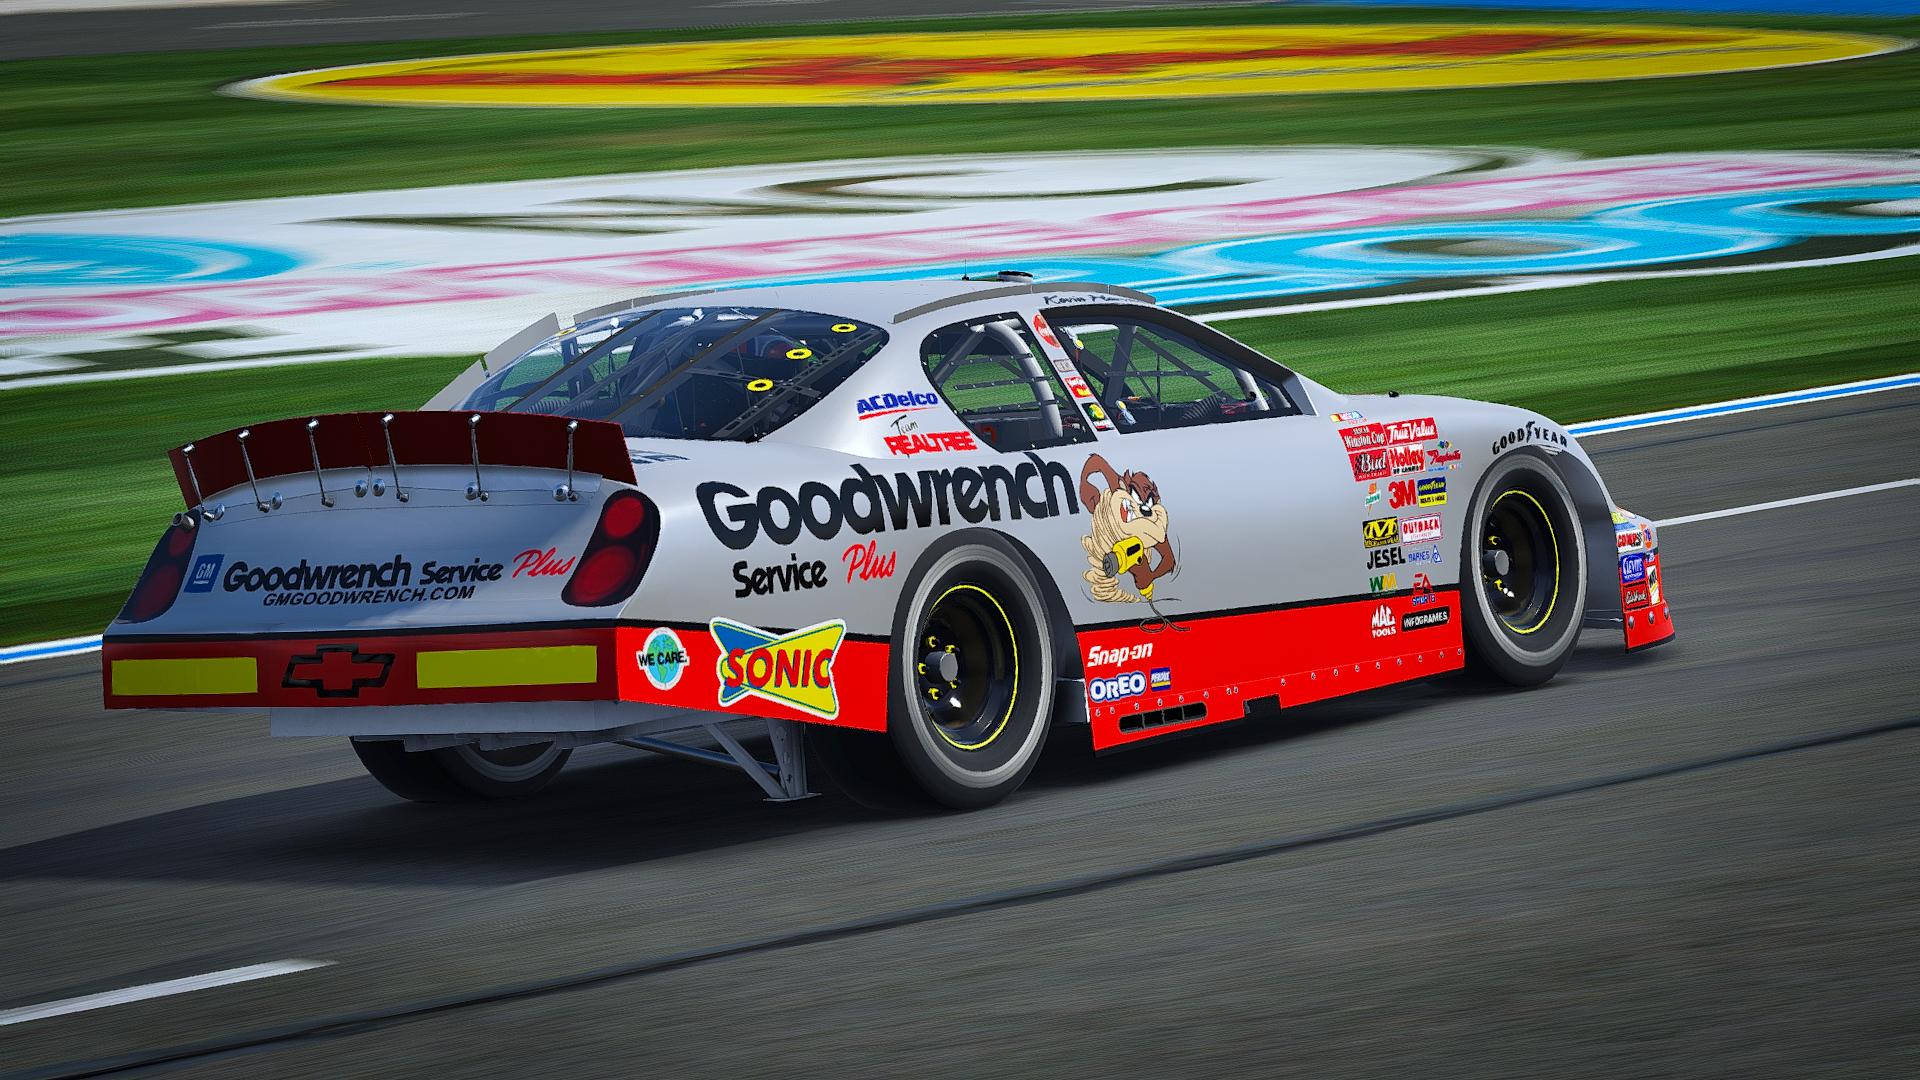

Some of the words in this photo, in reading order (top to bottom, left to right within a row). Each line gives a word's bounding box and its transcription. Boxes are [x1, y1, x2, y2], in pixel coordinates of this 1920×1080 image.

[857, 391, 938, 414] ACDelco
[890, 414, 919, 438] Team
[1492, 421, 1568, 455] GOODYEAR
[884, 431, 977, 455] REALTREE
[696, 451, 1080, 549] Goodwrench
[1388, 479, 1416, 509] 3M
[224, 554, 412, 592] Goodwrench
[420, 558, 504, 586] Service
[512, 547, 577, 580] Plus
[733, 553, 828, 598] Service
[842, 539, 897, 584] Plus
[1367, 546, 1405, 570] JESEL
[195, 562, 214, 579] GM
[263, 586, 477, 607] GMGOODWRENCH.COM
[1371, 604, 1396, 628] MAC
[1372, 626, 1397, 638] TOOLS
[638, 653, 655, 667] WE
[1087, 642, 1153, 667] Snap-on
[724, 648, 835, 688] SONIC
[1089, 672, 1147, 702] OREO
